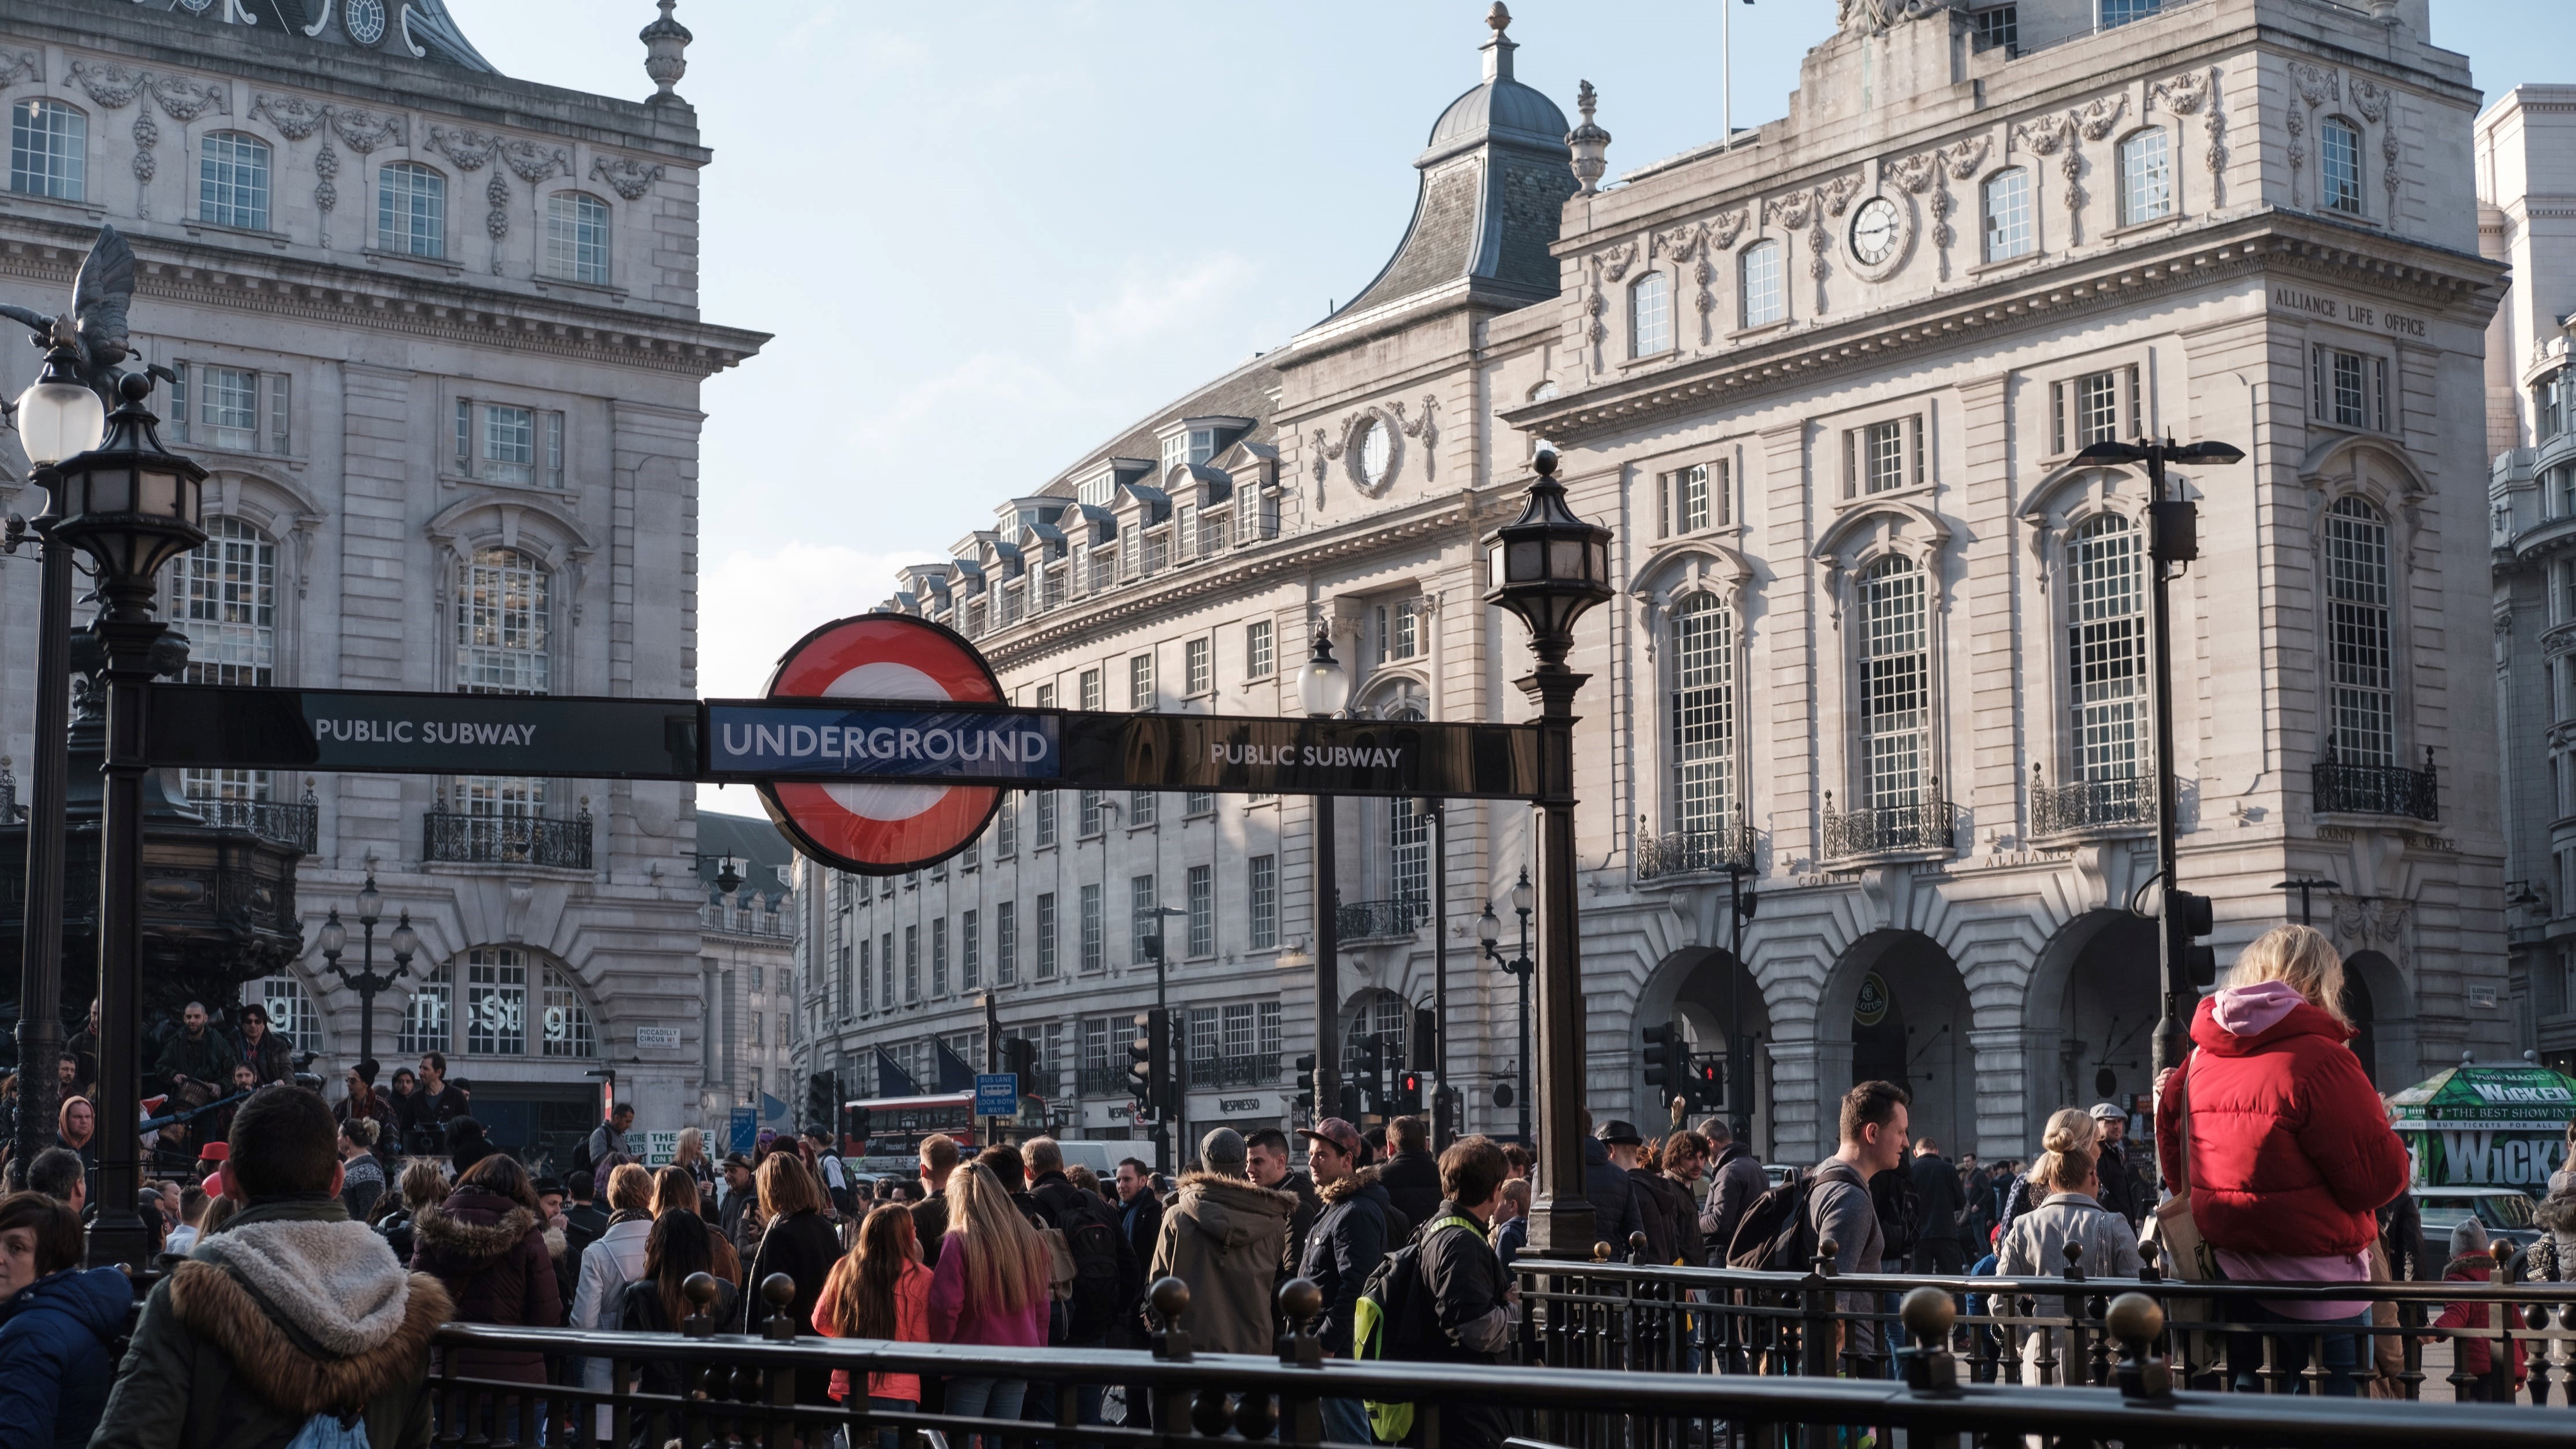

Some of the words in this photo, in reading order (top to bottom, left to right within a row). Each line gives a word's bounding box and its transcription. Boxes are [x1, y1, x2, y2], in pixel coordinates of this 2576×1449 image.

[2276, 288, 2336, 317] ALLIANCE
[2347, 304, 2374, 326] LIFE
[2385, 313, 2426, 336] OFFICE
[316, 719, 412, 742] PUBLIC
[422, 722, 537, 745] SUBWAY
[723, 723, 1047, 762] UNDERGROUND
[1211, 744, 1295, 766] PUBLIC
[1302, 746, 1401, 767] SUBWAY
[2316, 826, 2355, 841] COUNTY
[2403, 833, 2417, 846] IRE
[2425, 835, 2455, 850] OFFICE
[1799, 868, 1862, 886] COUNTY
[1908, 861, 1946, 875] FIRE
[1986, 846, 2076, 867] ALLIANCE
[2126, 838, 2157, 852] LIF
[1856, 998, 1882, 1011] LOTUS
[482, 995, 566, 1042] Stig
[1219, 1098, 1260, 1114] NESPRESSO
[2480, 1108, 2508, 1117] BEST
[2512, 1108, 2549, 1117] SHOW
[2553, 1108, 2566, 1117] IN
[624, 1134, 646, 1143] EATRE
[629, 1143, 645, 1154] KETS
[651, 1132, 712, 1142] THEE
[654, 1143, 710, 1152] TICS
[2441, 1131, 2568, 1184] WICK
